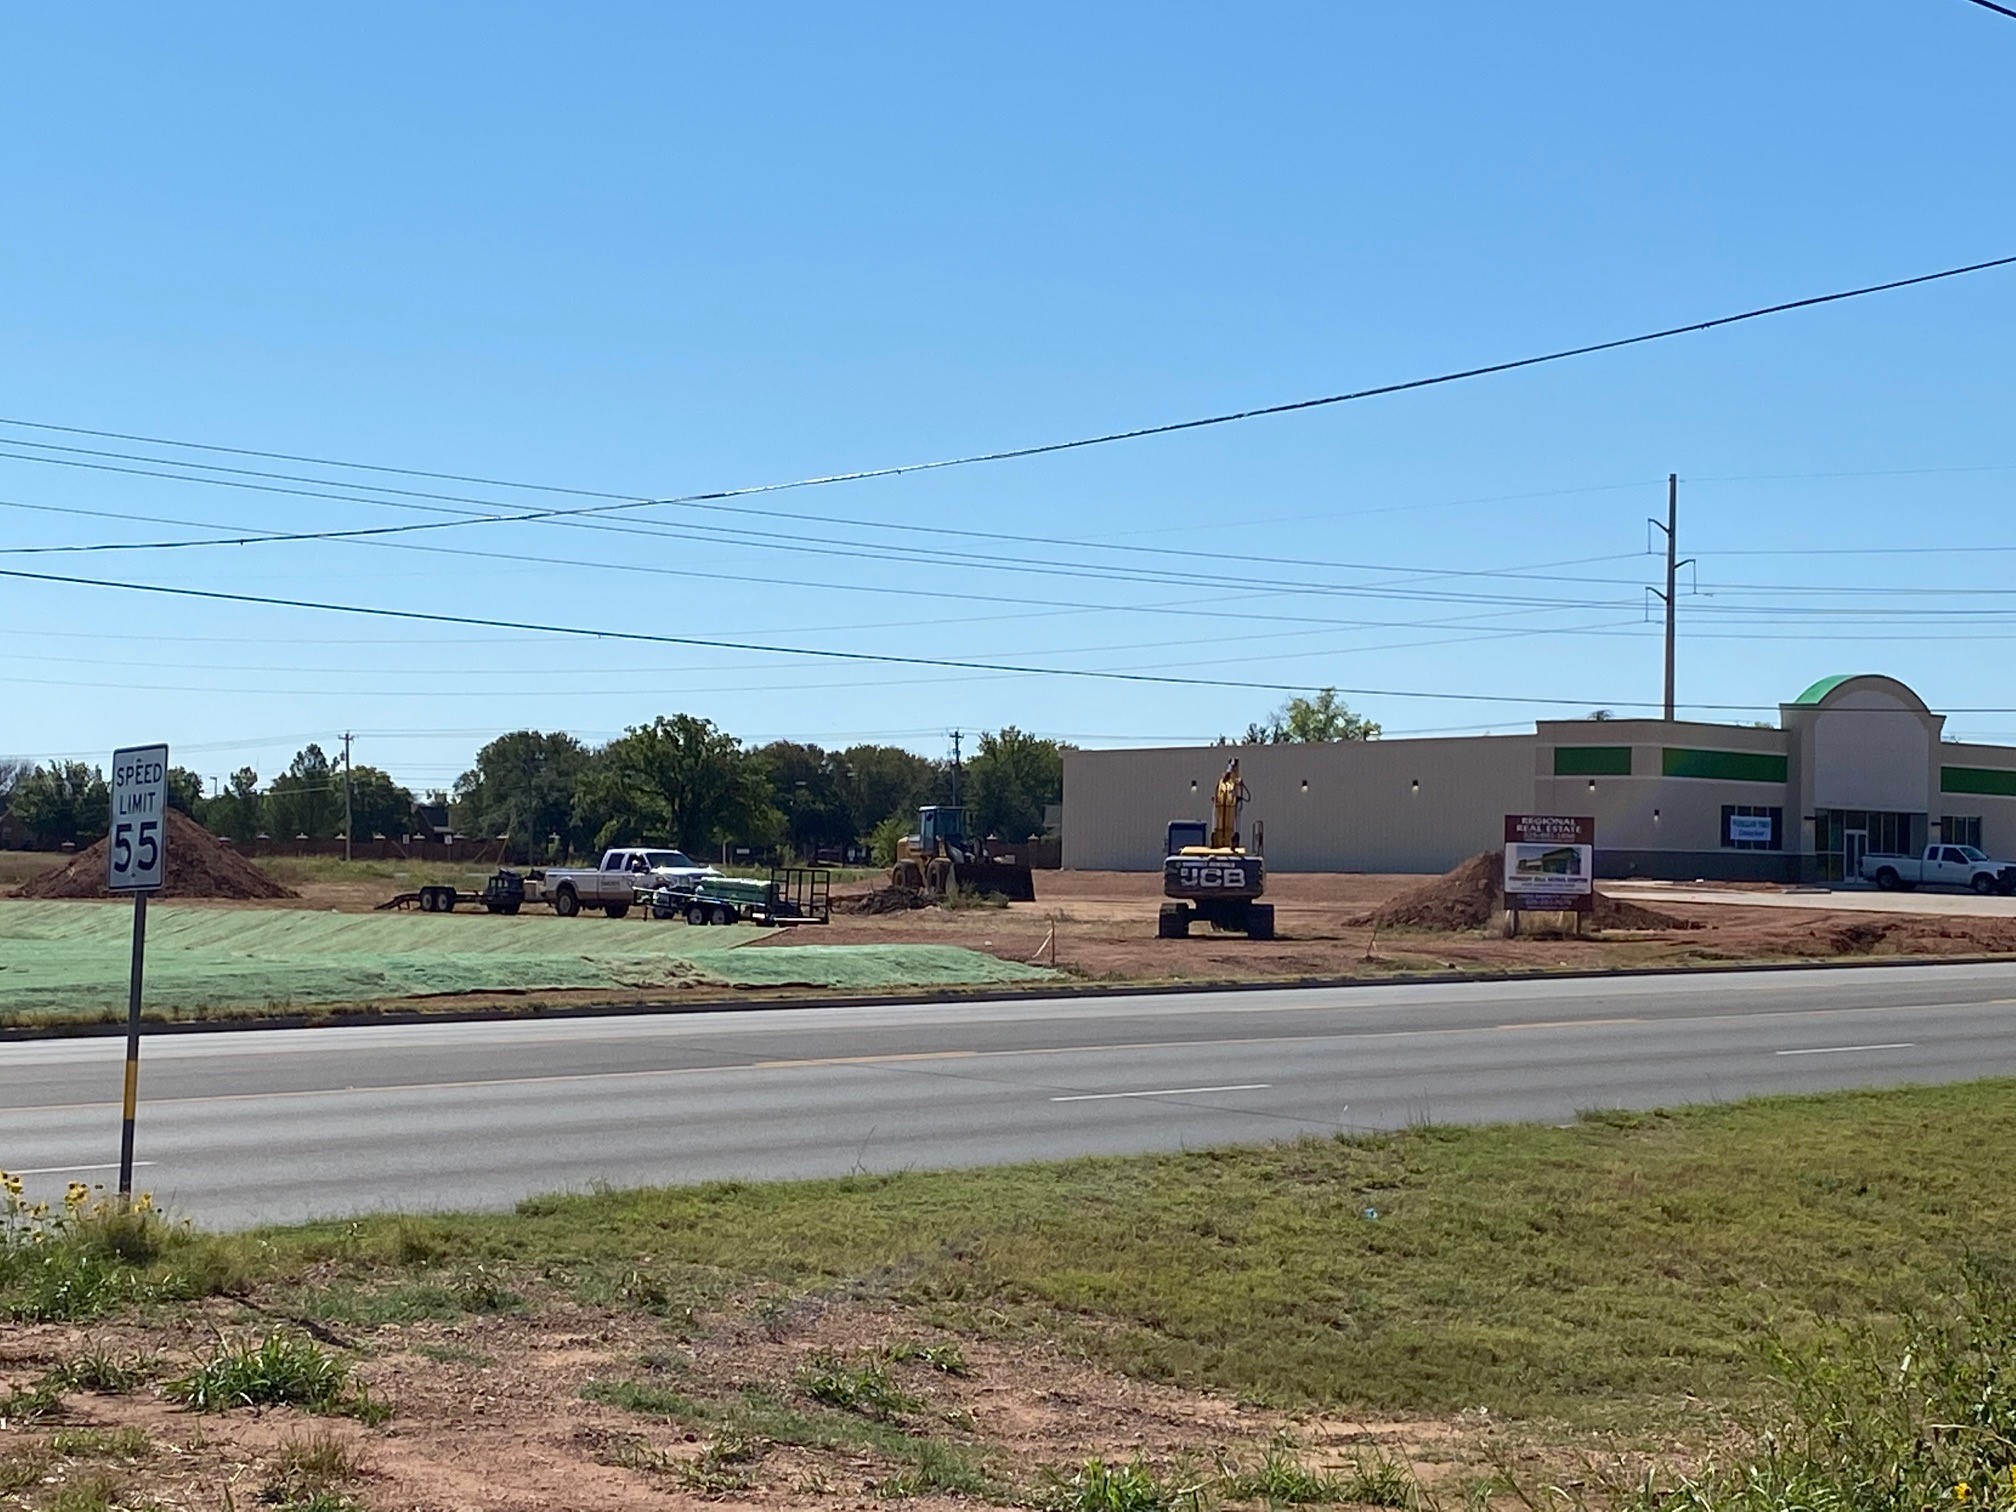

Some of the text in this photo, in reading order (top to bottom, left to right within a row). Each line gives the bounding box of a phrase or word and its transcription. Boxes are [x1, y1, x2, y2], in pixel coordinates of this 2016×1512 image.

[117, 762, 163, 787] SPEED
[119, 791, 156, 815] LIMIT
[1516, 824, 1582, 834] REAL ESTATE
[1521, 817, 1576, 825] REGIONAL
[114, 820, 158, 873] 55
[1180, 868, 1246, 888] JCB
